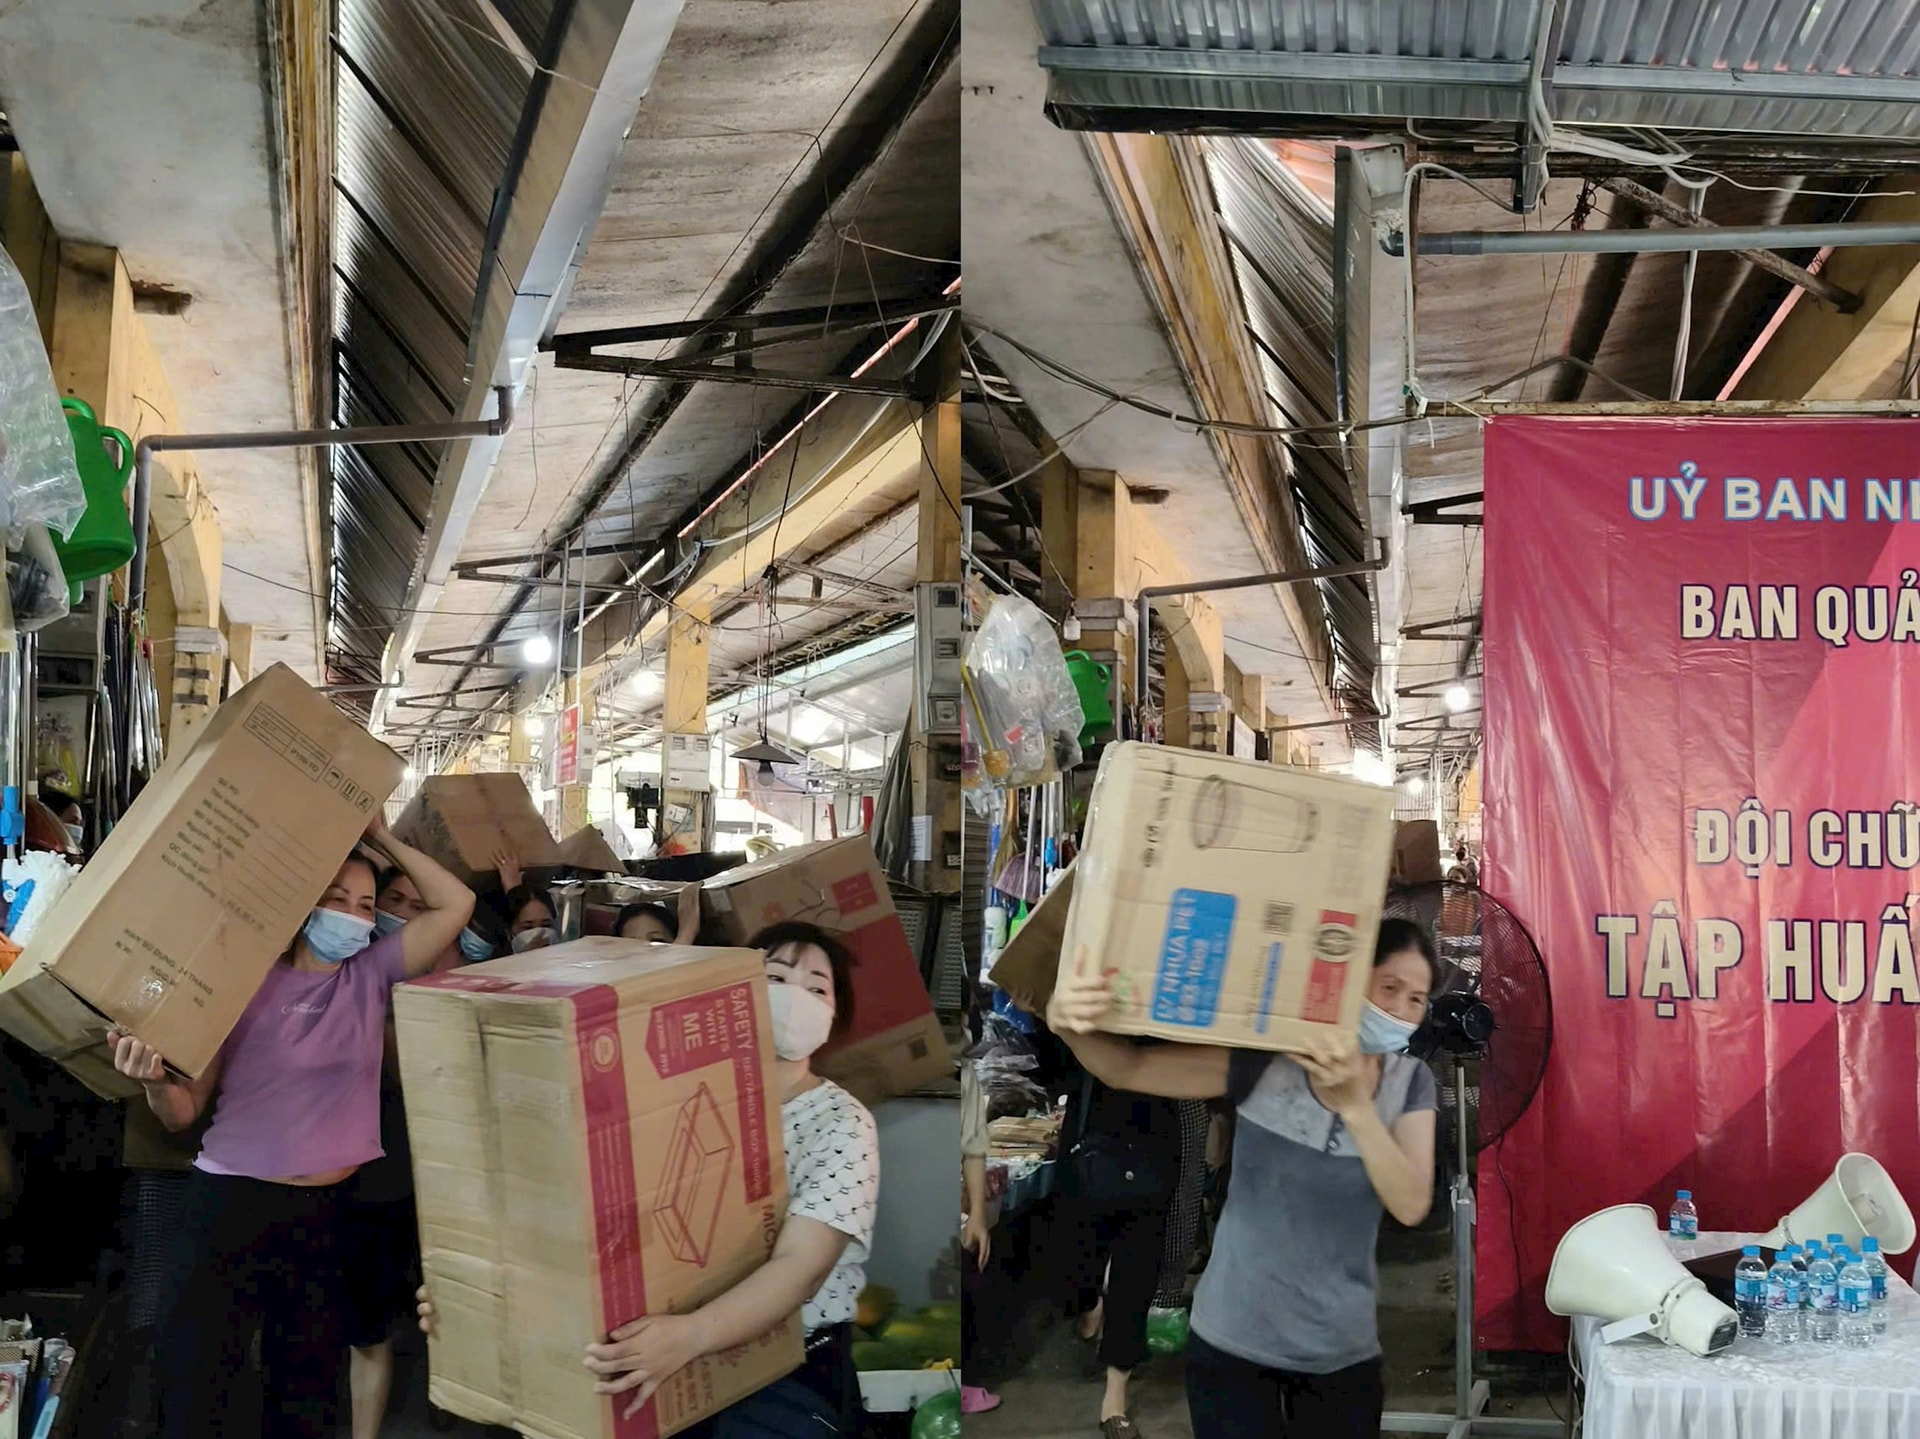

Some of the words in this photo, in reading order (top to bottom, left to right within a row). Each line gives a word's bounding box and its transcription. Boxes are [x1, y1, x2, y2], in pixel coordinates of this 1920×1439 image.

[1629, 460, 1707, 521] UỶ
[1724, 477, 1847, 522] BAN
[1681, 583, 1798, 641] BAN
[1815, 568, 1920, 648] QUẢ
[1694, 798, 1792, 878] ĐỘI
[1596, 900, 1743, 1017] TẬP
[682, 1013, 702, 1051] ME
[705, 1009, 720, 1045] WITH
[714, 999, 729, 1053] STARTS
[729, 988, 753, 1050] SAFETY
